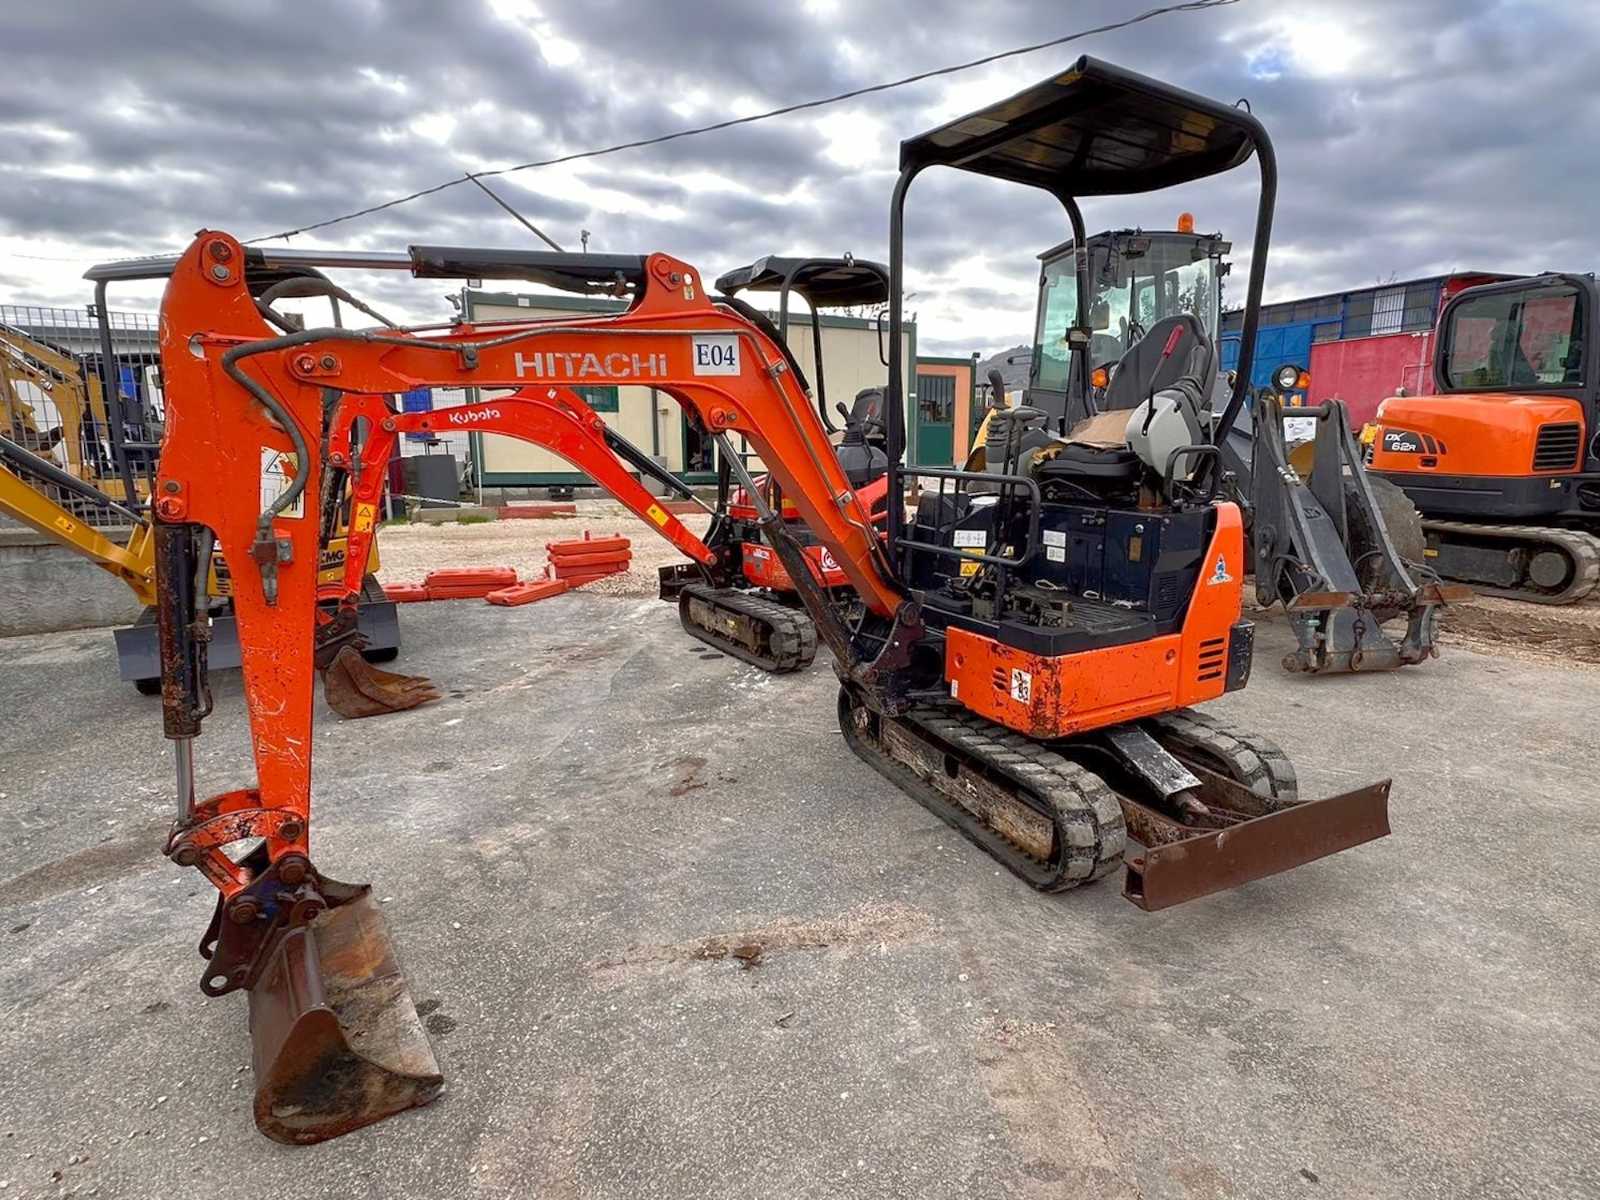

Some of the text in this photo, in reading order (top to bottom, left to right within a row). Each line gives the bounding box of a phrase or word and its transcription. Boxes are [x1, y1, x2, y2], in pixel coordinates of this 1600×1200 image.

[696, 344, 736, 367] E04
[514, 352, 668, 378] HITACHI
[448, 407, 501, 425] Kubota
[1384, 431, 1408, 442] DX
[1391, 441, 1417, 452] 62R
